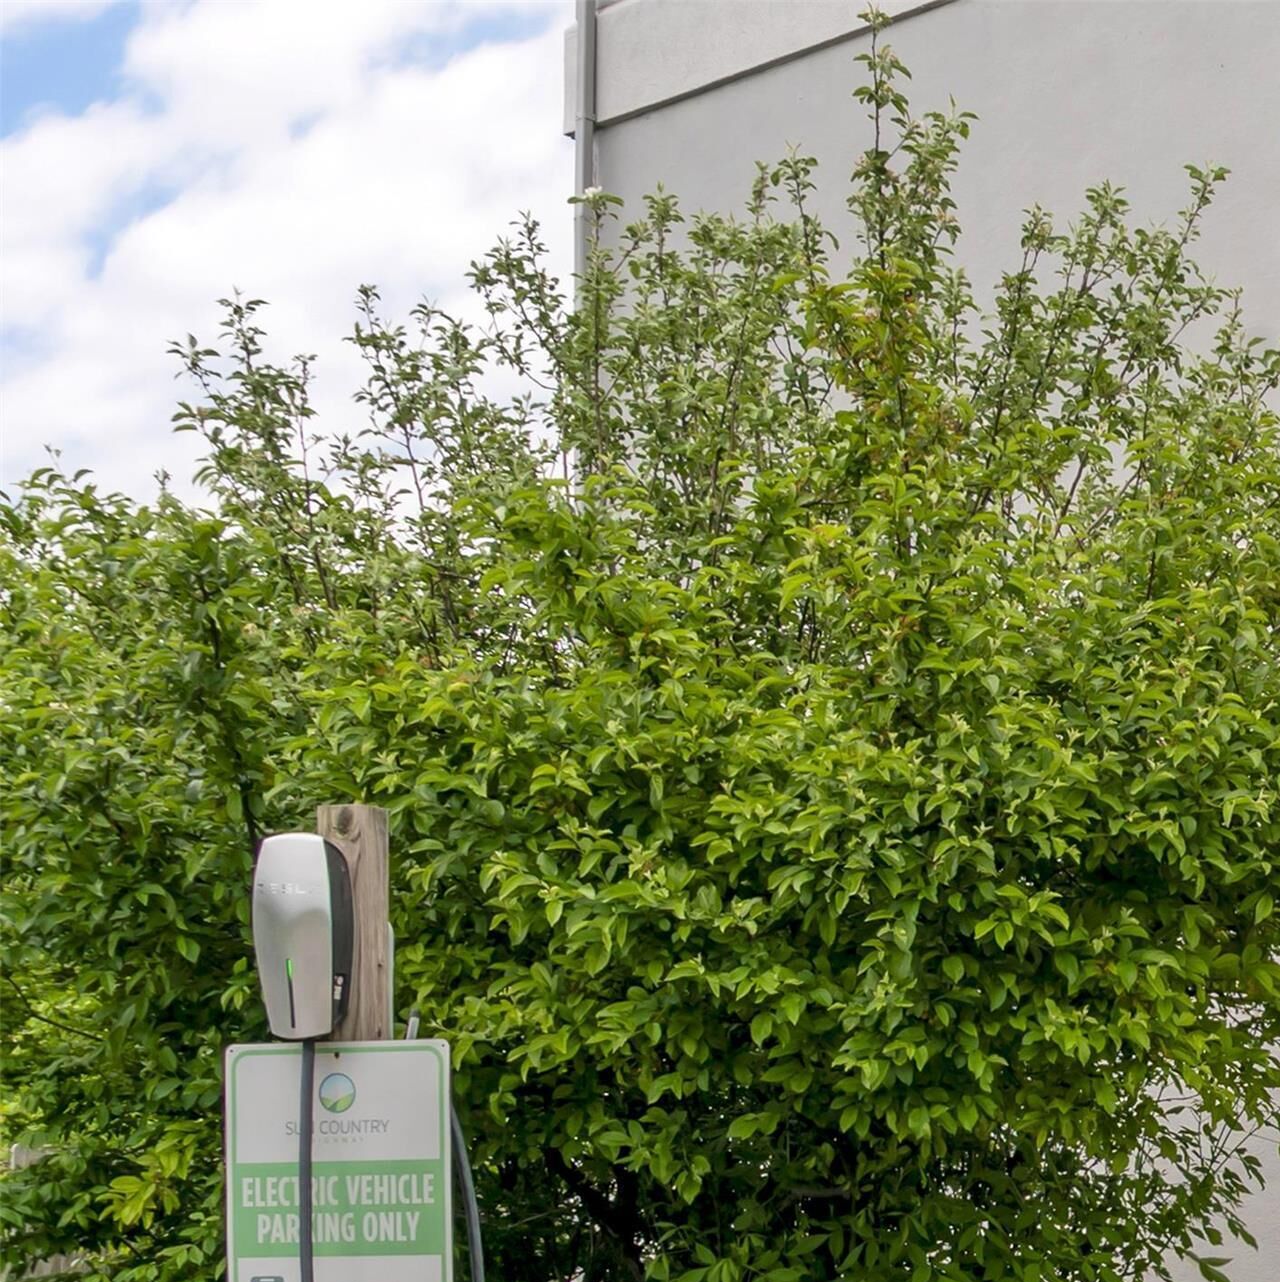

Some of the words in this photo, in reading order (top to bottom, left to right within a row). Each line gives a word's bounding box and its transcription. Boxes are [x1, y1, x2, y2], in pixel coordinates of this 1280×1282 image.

[285, 1121, 314, 1136] SU
[319, 1119, 390, 1135] COUNTRY
[346, 1174, 435, 1205] VEHICLE
[257, 1212, 355, 1244] PARING
[363, 1211, 420, 1241] ONLY
